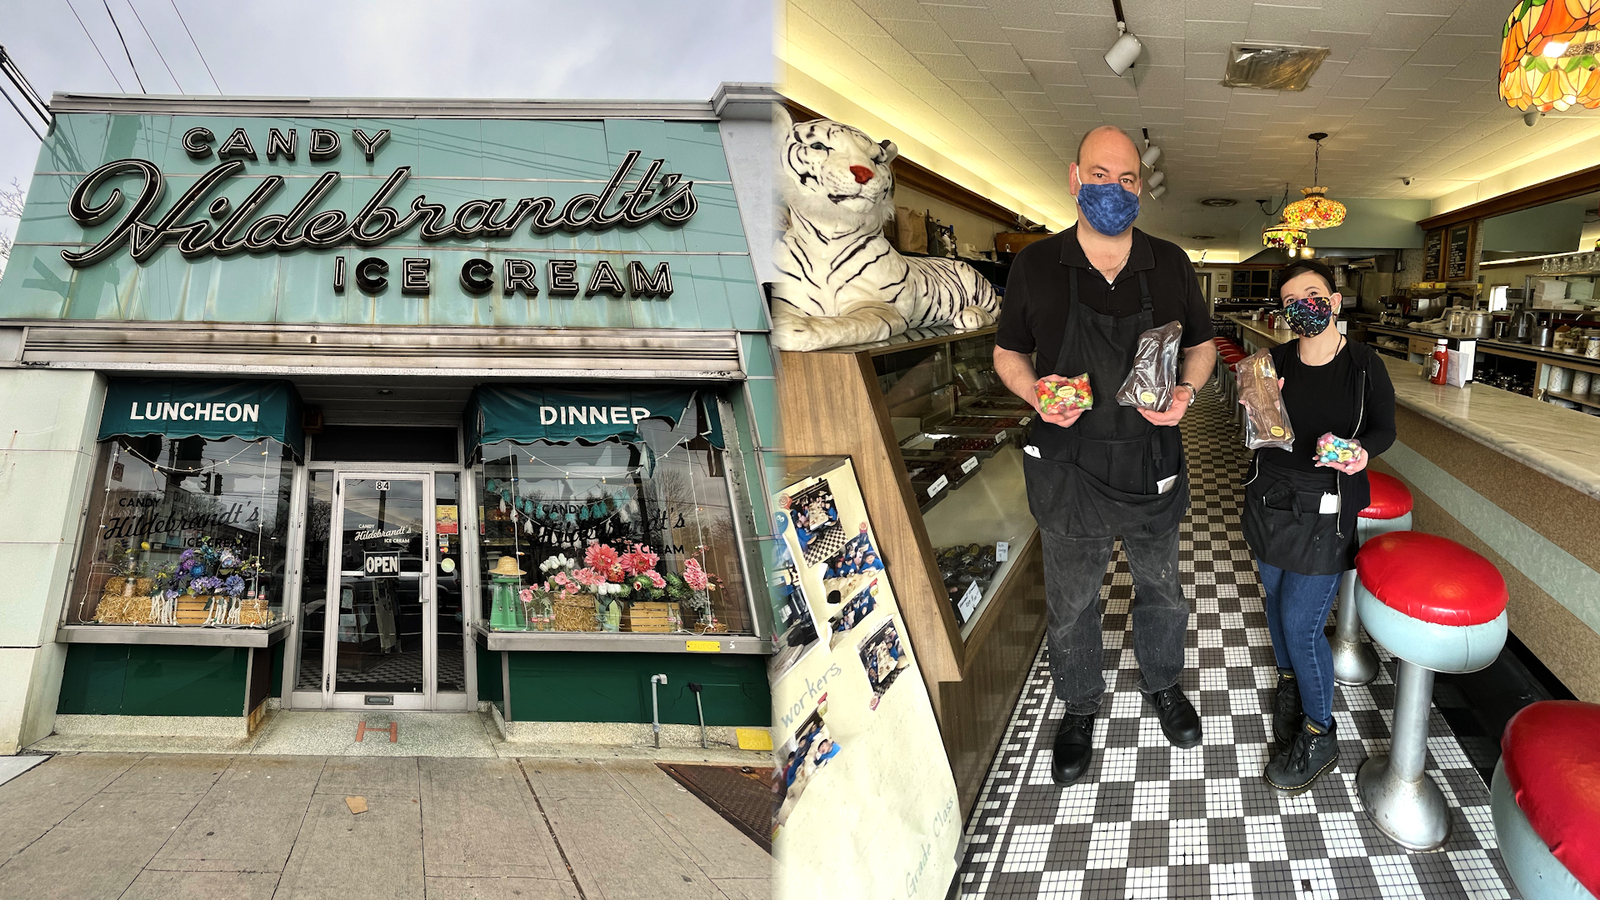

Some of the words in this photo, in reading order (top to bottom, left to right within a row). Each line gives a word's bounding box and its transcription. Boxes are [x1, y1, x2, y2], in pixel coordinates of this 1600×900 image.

[182, 127, 391, 161] CANDY
[61, 149, 699, 268] Hildebrandt's
[334, 256, 431, 295] ICE
[460, 257, 674, 298] CREAM
[130, 401, 260, 423] LUNCHEON
[376, 482, 390, 490] 84
[118, 497, 161, 508] CANDY
[542, 504, 585, 514] CANDY
[104, 501, 260, 540] Hildebrandt's
[354, 525, 412, 542] Hildebrandt's
[183, 537, 202, 548] ICE
[366, 556, 398, 573] OPEN
[688, 642, 718, 651] CAUTION
[906, 843, 932, 898] Grade
[932, 796, 954, 838] Class
